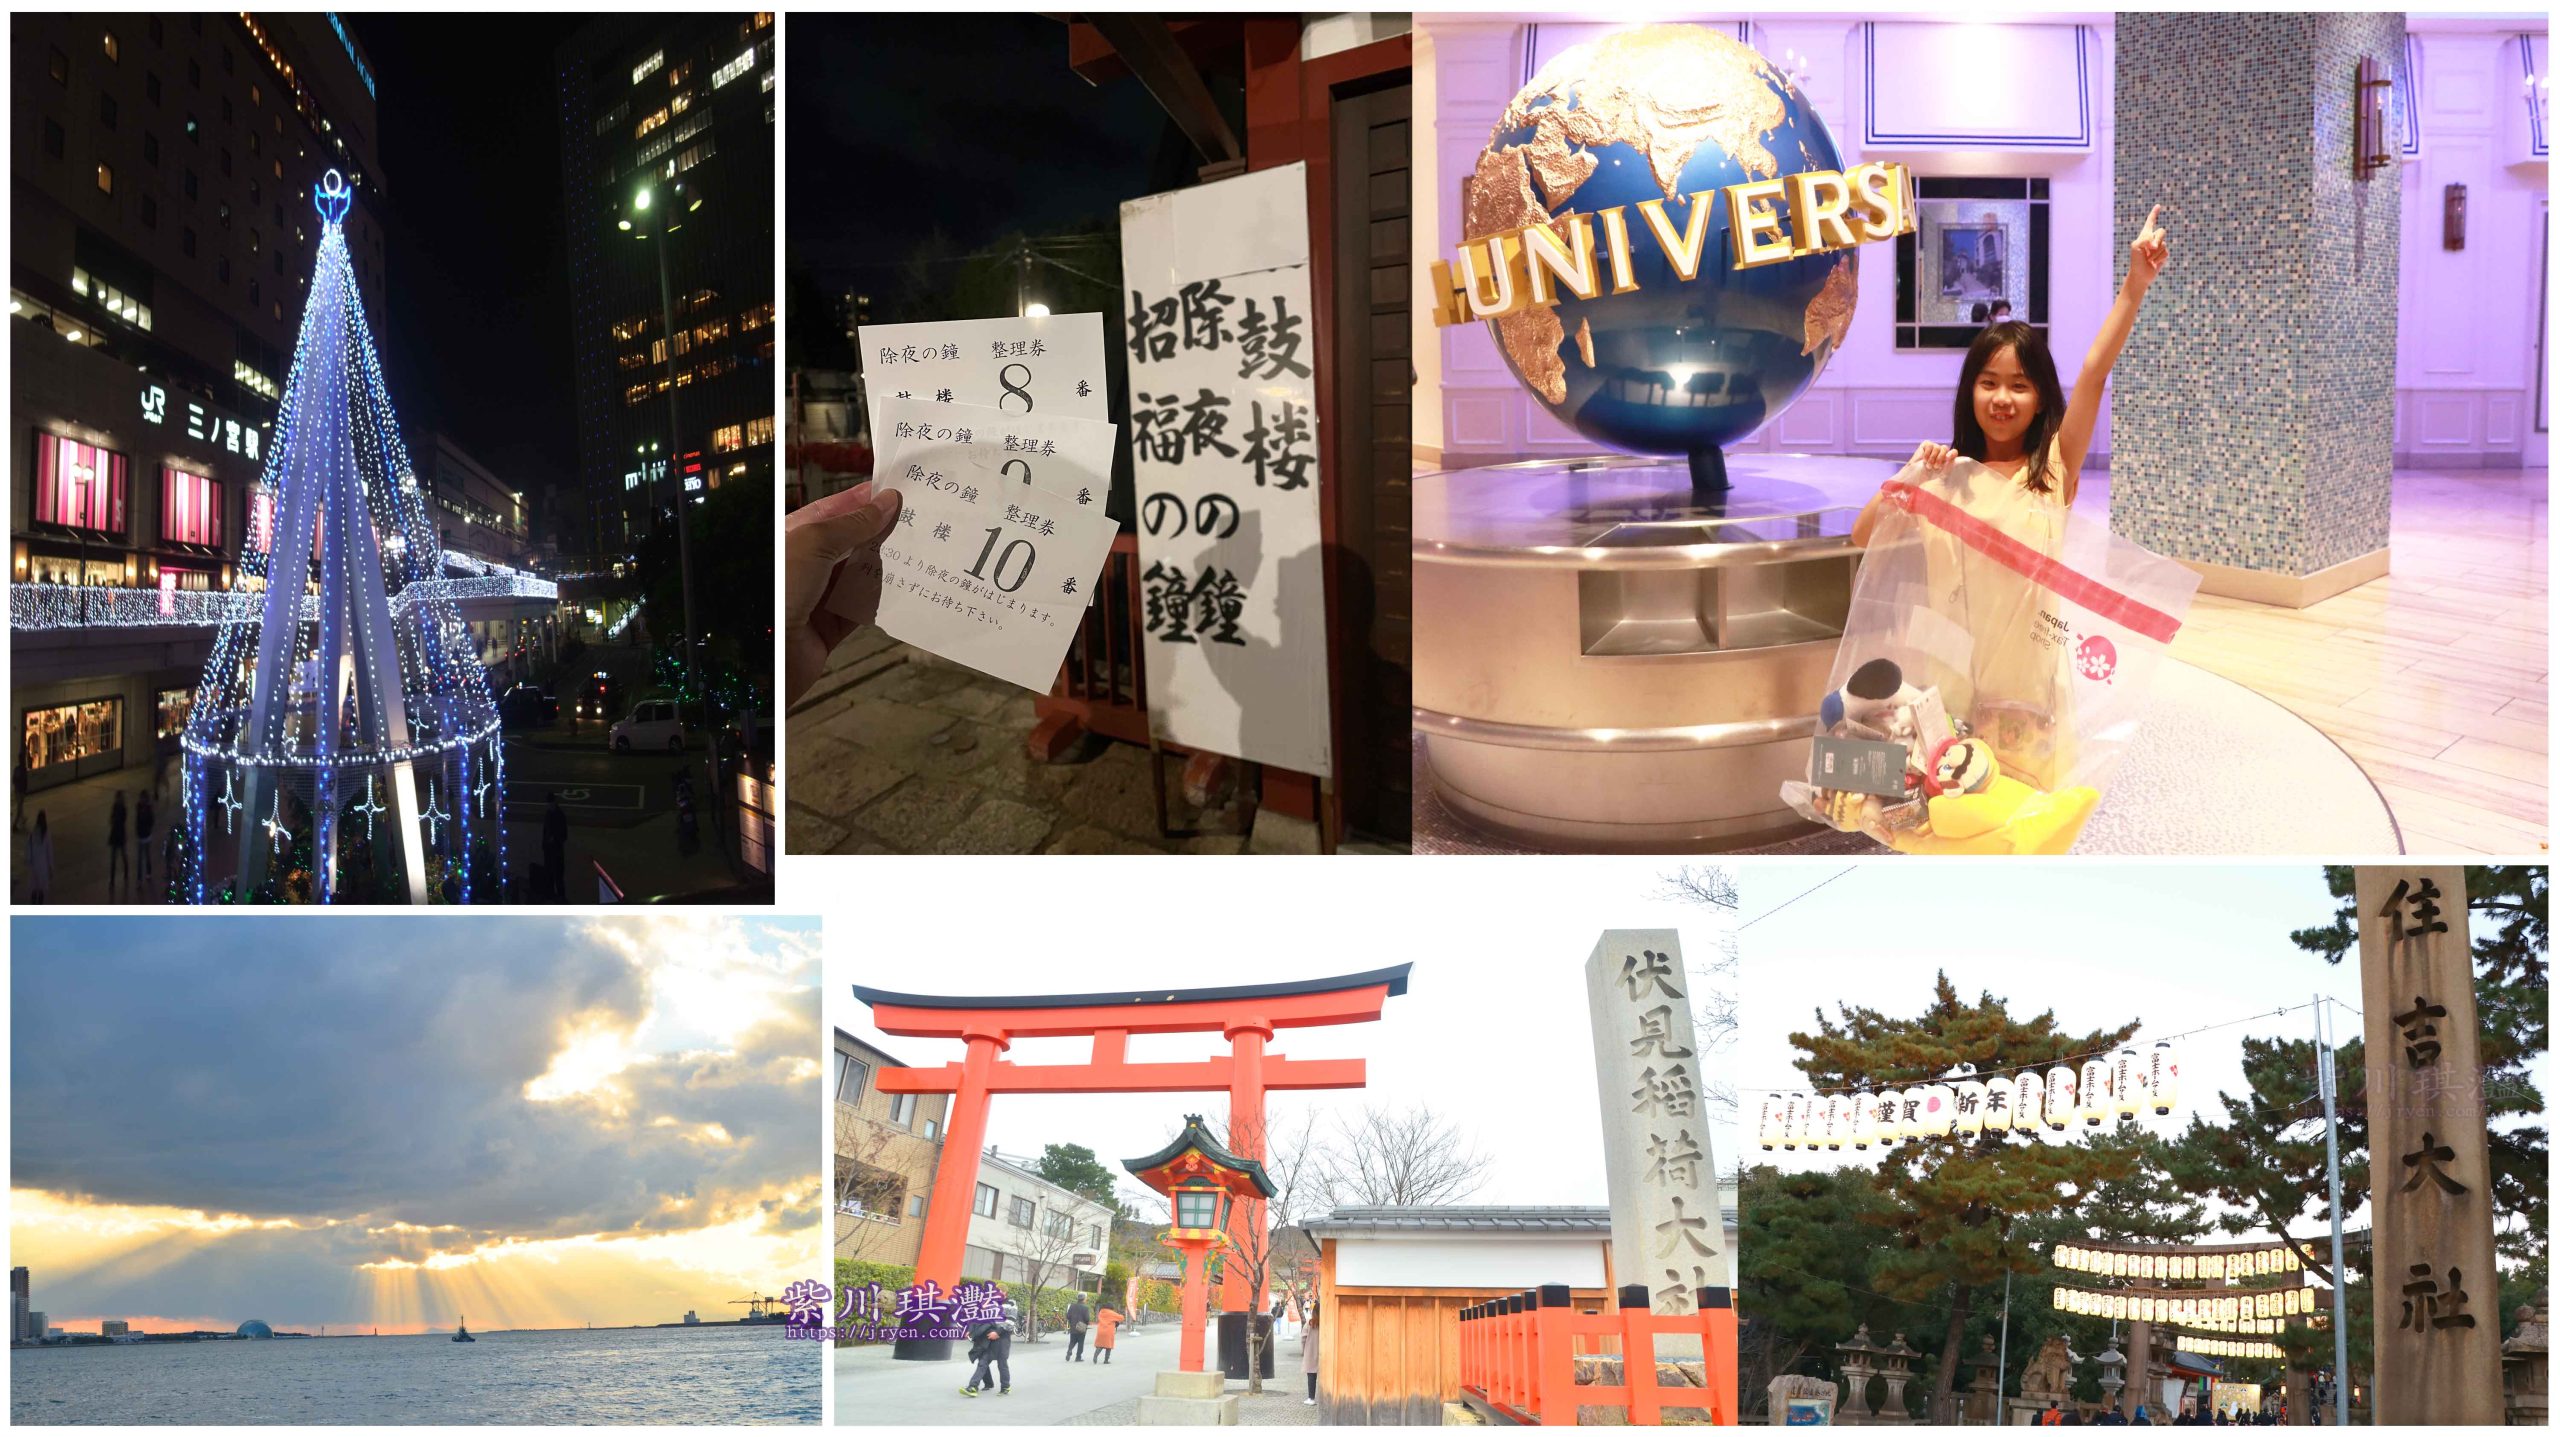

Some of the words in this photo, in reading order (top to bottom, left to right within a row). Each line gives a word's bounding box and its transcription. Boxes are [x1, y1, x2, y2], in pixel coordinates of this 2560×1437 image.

[880, 343, 960, 365] 除夜の鐘
[991, 339, 1047, 359] 整理券
[141, 385, 165, 416] JR
[999, 363, 1034, 413] 8
[1076, 380, 1092, 398] 番
[1238, 296, 1317, 490] 鼓楼
[187, 403, 259, 461] 三ノ宮駅
[895, 421, 974, 445] 除夜の鐘
[1003, 434, 1057, 458] 整理券
[1128, 290, 1199, 645] 招福の鐘
[1182, 279, 1248, 647] 除夜の鐘
[906, 464, 980, 506] 除夜の鐘
[1003, 504, 1055, 537] 整理券
[1076, 487, 1093, 505] 番
[963, 526, 1037, 593] 10
[1060, 576, 1078, 596] 番
[1958, 1088, 2008, 1115] 新年
[2379, 877, 2476, 1333] 住吉大社
